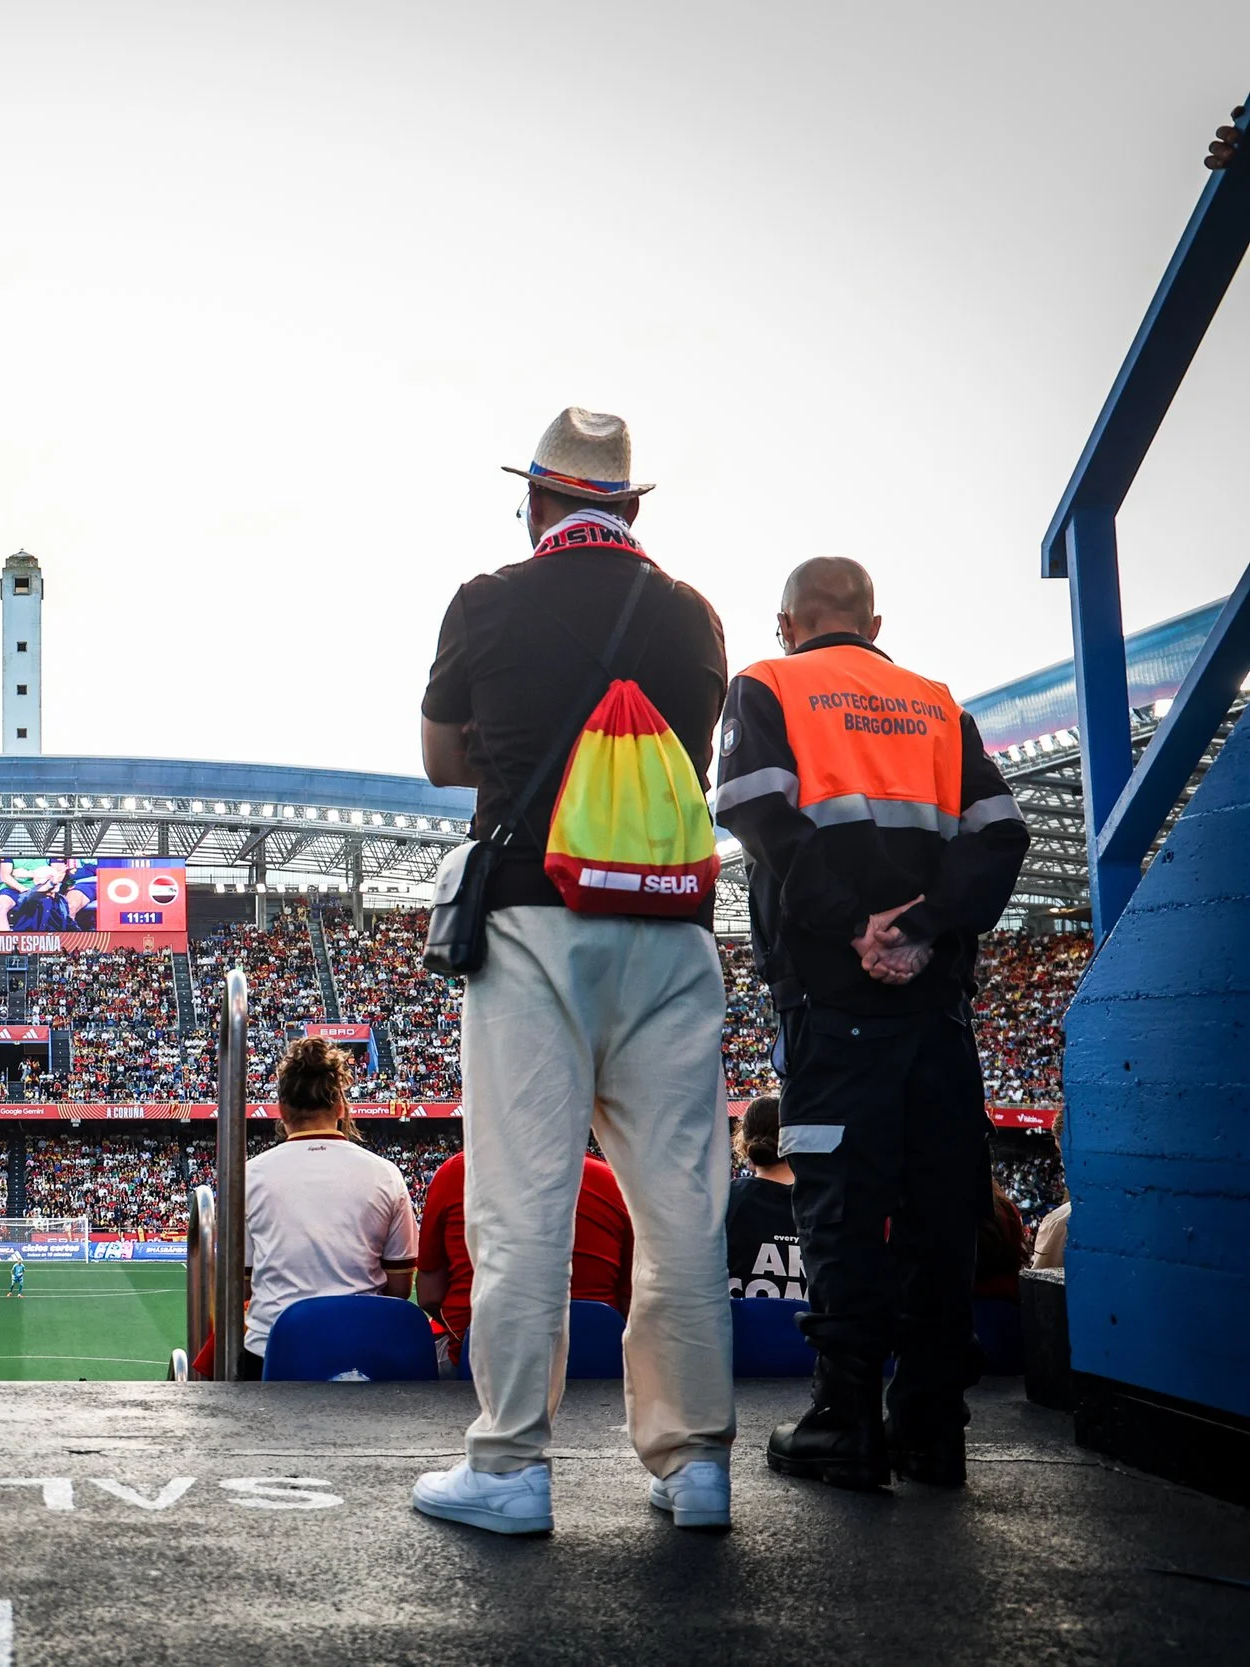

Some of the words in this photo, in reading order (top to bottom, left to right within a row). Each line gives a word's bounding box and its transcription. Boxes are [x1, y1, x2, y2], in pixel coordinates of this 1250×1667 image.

[809, 692, 908, 712] PROTECCION
[911, 700, 947, 722] CIVIL
[844, 713, 927, 735] BERGONDO
[107, 877, 139, 904] 0
[644, 874, 699, 894] SEUR
[127, 912, 156, 923] 11:11
[21, 932, 61, 951] ESPAÑA
[0, 1108, 23, 1116] Google
[106, 1108, 112, 1118] A
[114, 1105, 145, 1118] CORUÑA
[358, 1107, 389, 1116] mapfre
[21, 1244, 48, 1252] ciclos
[49, 1244, 80, 1252] cortos
